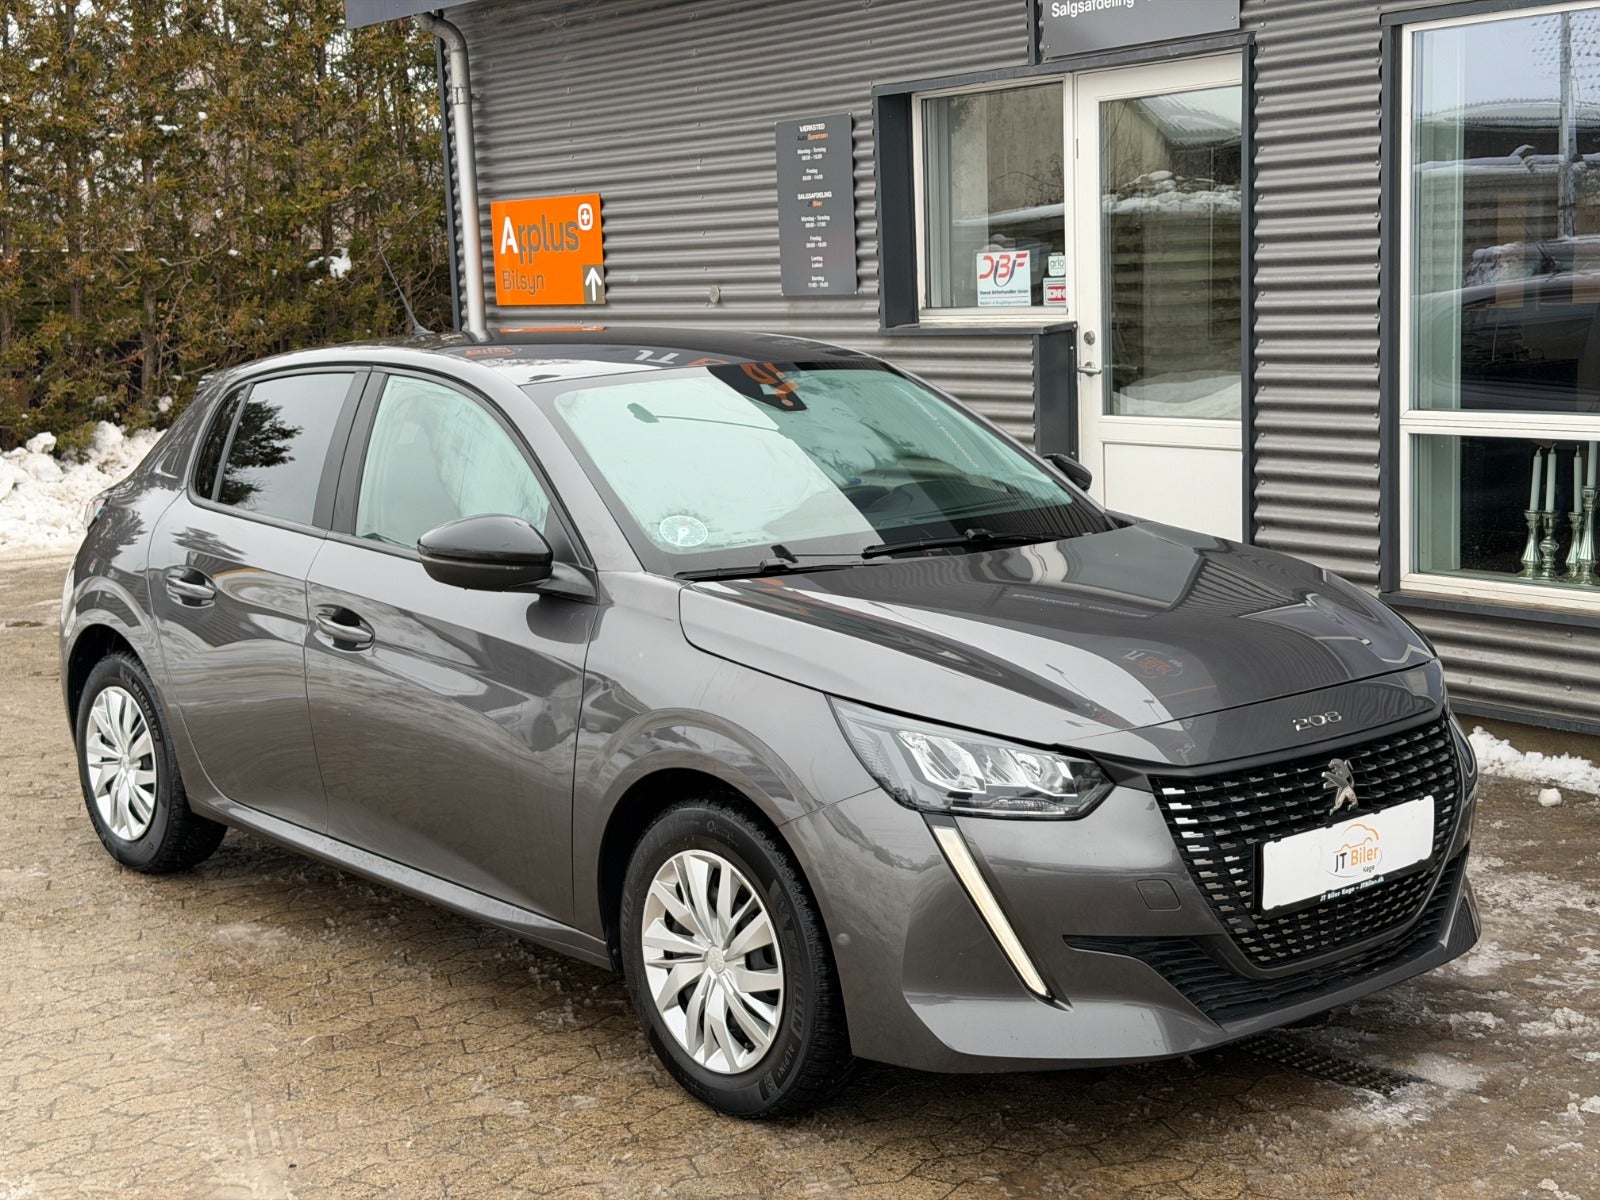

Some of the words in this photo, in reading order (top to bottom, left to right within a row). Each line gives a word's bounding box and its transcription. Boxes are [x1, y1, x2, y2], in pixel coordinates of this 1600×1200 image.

[502, 270, 544, 295] Bilsyn
[1293, 711, 1342, 731] 208
[1334, 852, 1347, 873] JT
[1350, 846, 1379, 867] Biler
[1327, 891, 1340, 900] Biler
